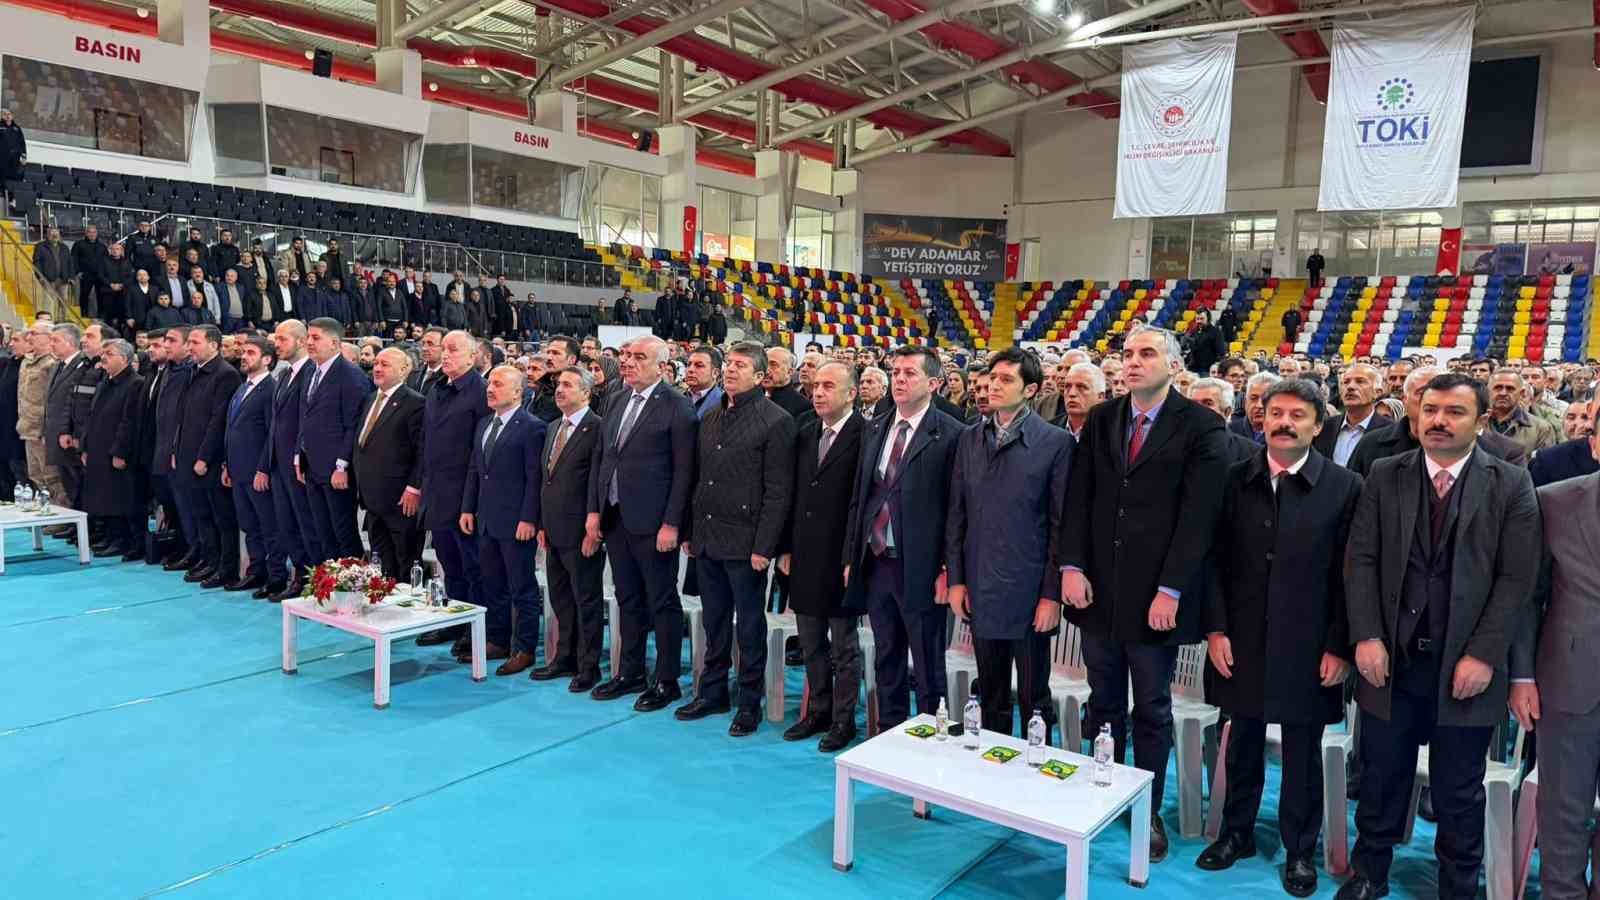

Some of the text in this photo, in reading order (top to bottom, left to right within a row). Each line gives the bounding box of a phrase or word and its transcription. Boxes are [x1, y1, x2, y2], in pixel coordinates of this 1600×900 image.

[75, 36, 141, 64] BASIN
[514, 131, 550, 149] BASIN
[919, 249, 981, 261] ADAMLAR
